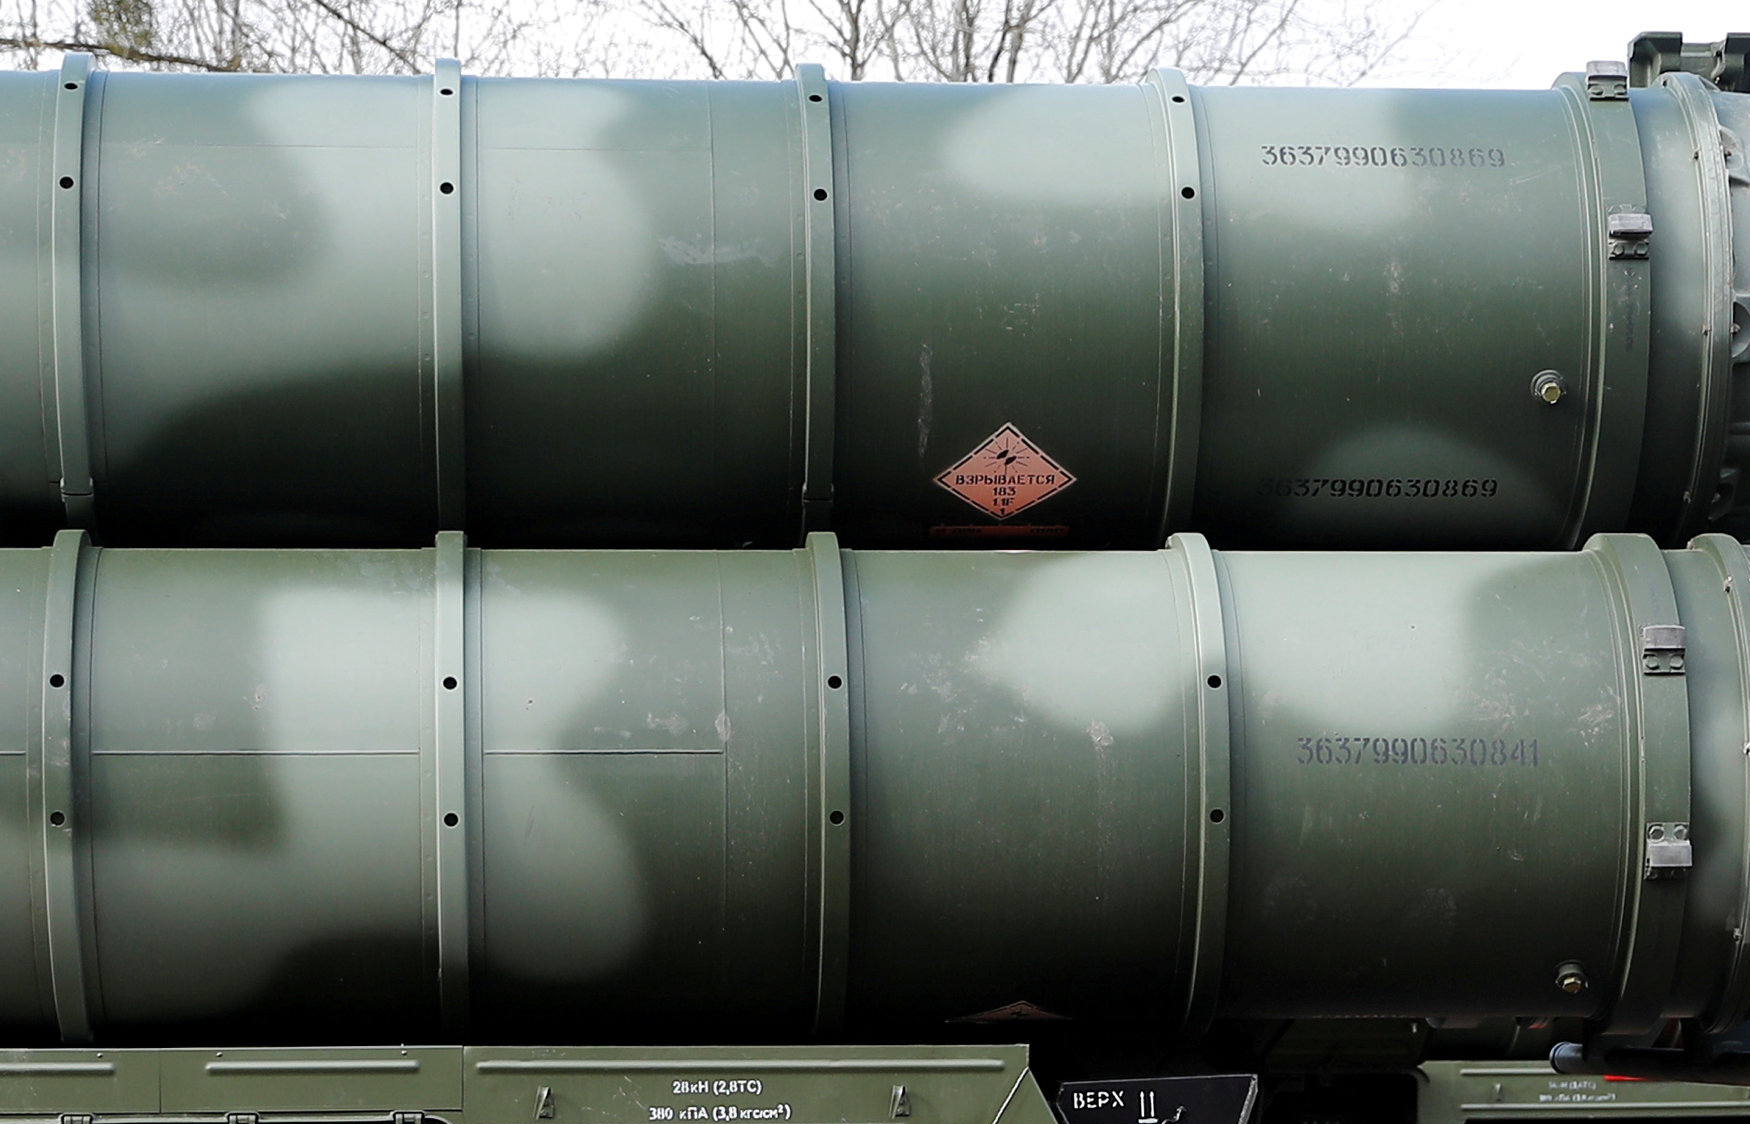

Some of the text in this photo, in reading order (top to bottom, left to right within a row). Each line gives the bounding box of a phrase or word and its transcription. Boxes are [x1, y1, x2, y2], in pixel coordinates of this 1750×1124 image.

[1260, 145, 1506, 169] 3637990630869
[955, 474, 1056, 486] ВЗРЫВАЕТСЯ
[1258, 476, 1498, 499] 3637990630869
[992, 486, 1016, 496] 183
[1296, 736, 1540, 768] 3637990630841
[1073, 1090, 1125, 1109] ВЕРХ
[648, 1107, 673, 1121] 380
